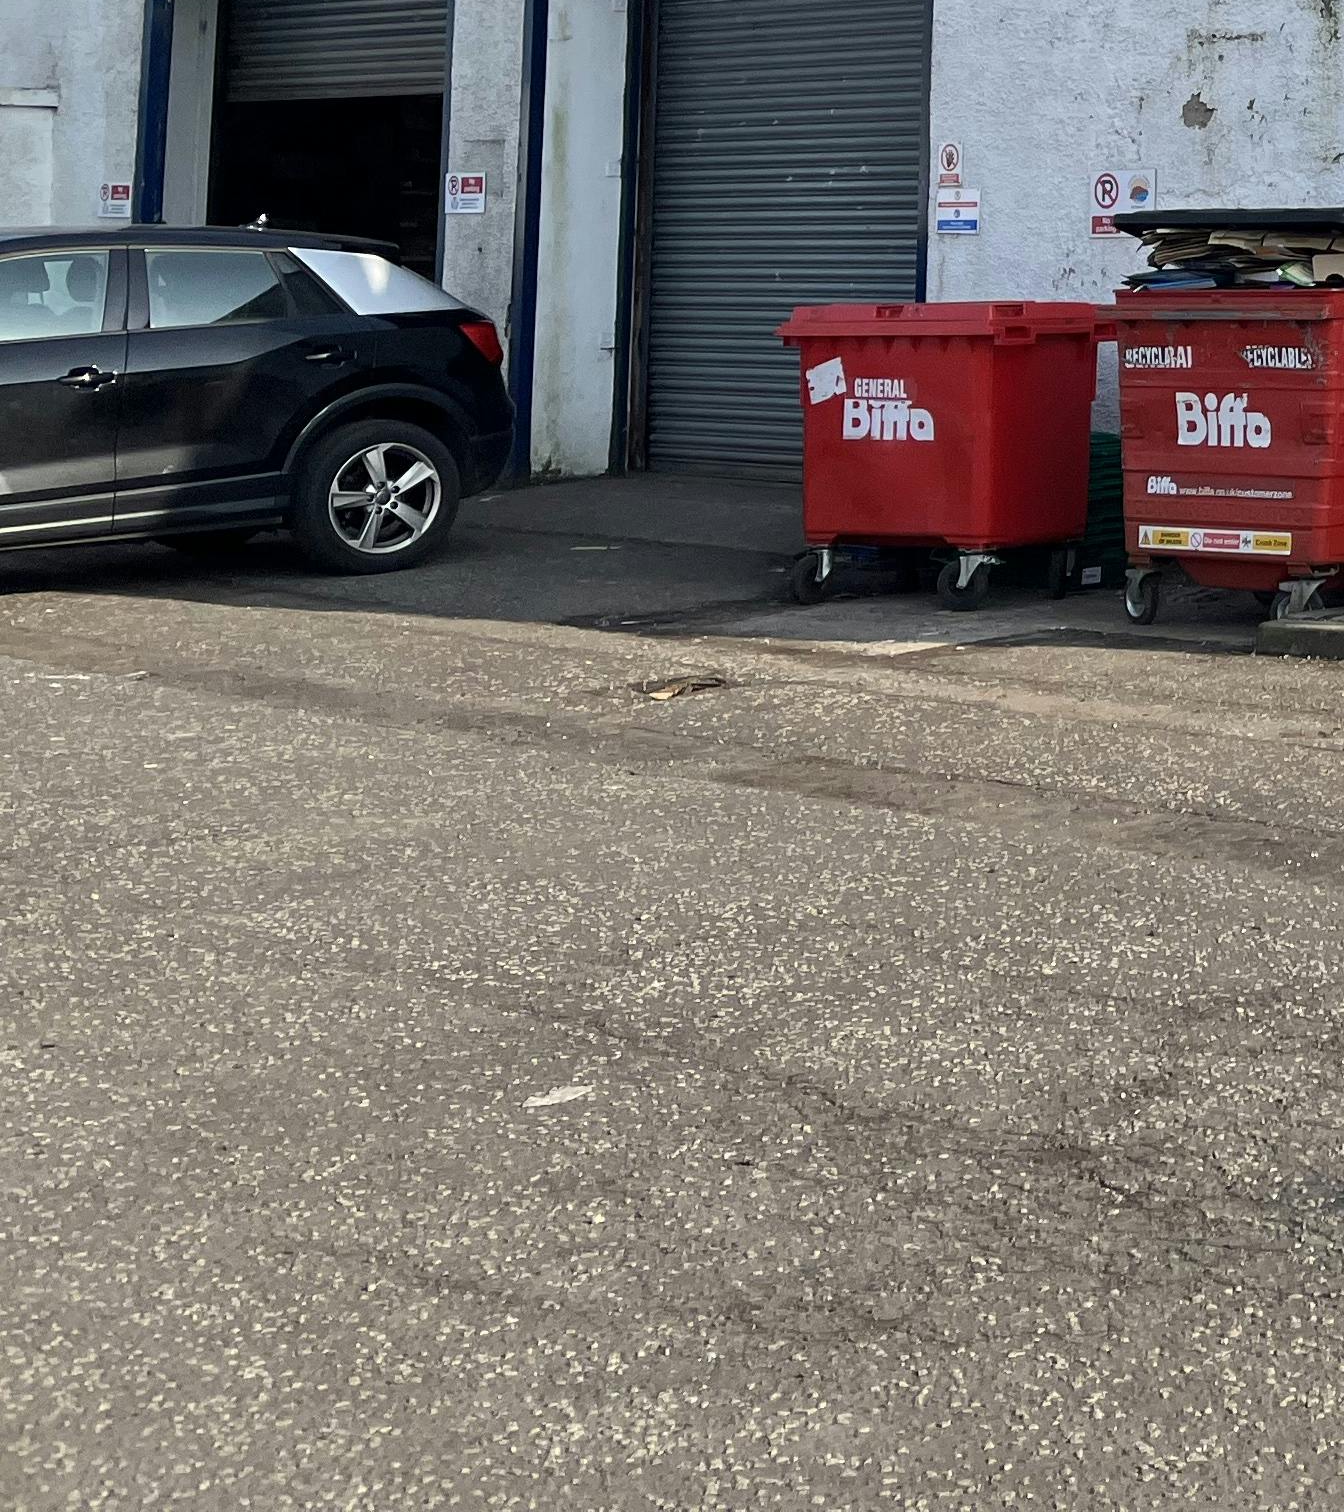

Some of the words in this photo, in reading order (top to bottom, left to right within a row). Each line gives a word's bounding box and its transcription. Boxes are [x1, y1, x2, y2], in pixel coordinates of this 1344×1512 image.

[854, 377, 908, 398] GENERAL
[843, 398, 935, 441] Biffa
[1175, 391, 1272, 448] Biffa
[1147, 475, 1177, 495] Biffa
